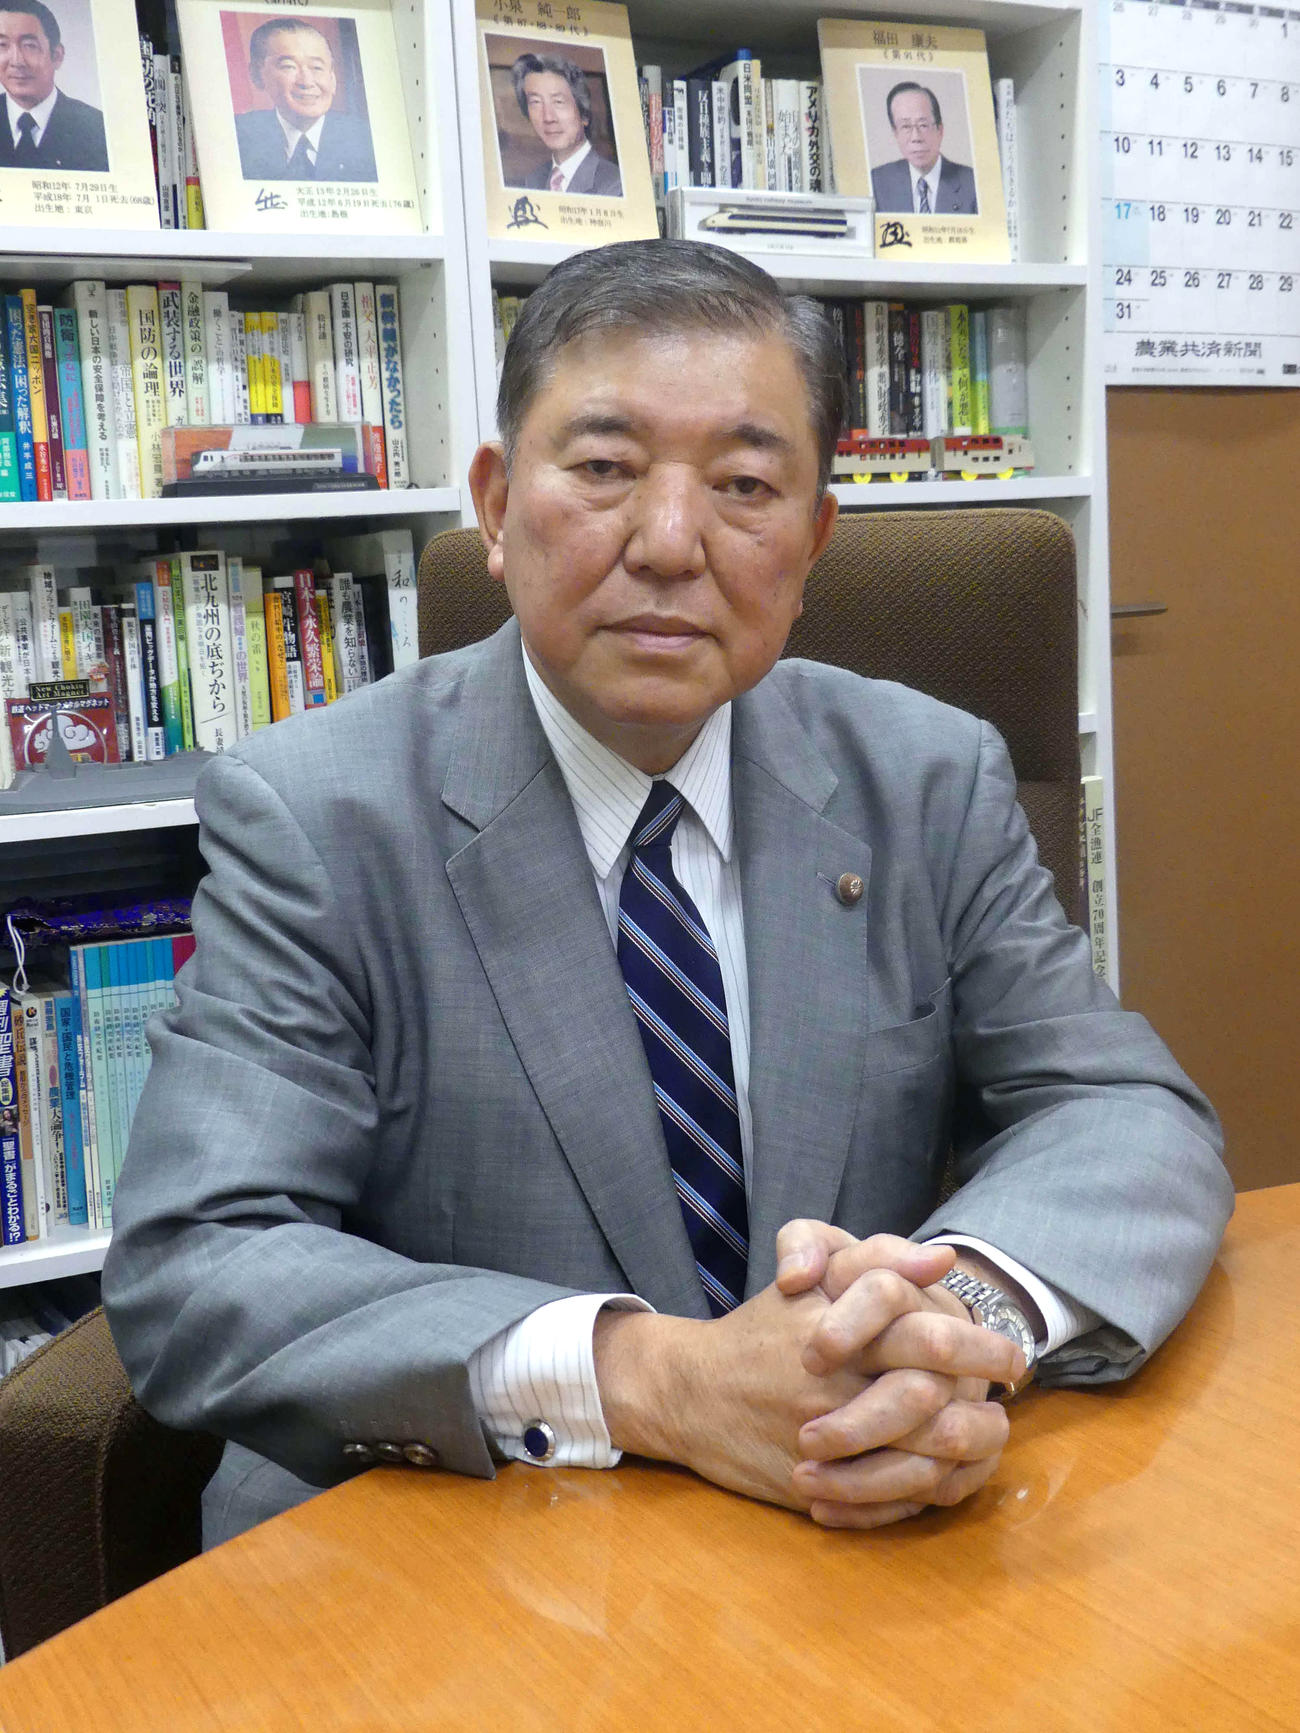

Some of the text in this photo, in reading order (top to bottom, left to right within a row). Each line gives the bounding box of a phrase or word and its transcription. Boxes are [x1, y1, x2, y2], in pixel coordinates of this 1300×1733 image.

[538, 2, 581, 20] 純一郎
[873, 30, 938, 49] 福田 康夫
[1281, 22, 1288, 38] 1
[1115, 69, 1290, 103] 3 4 5 6 7 8
[1114, 136, 1293, 166] 10 11 12 13 14 15
[1115, 203, 1293, 230] 17 18 19 20 21 22
[1115, 268, 1293, 292] 24 25 26 27 28 29
[1116, 302, 1132, 319] 31
[139, 309, 160, 397] 国防の論理
[163, 291, 185, 398] 武装する世界
[1134, 340, 1263, 359] 農業共済新聞
[9, 308, 32, 435] 困った憲法・困った解釈
[88, 309, 109, 441] 新しい日本の安全保障を考える
[379, 293, 403, 431] 新幹線がなかったら
[201, 573, 227, 714] 北九州の底ぢから
[339, 578, 359, 677] 誰も農業を知らない
[36, 685, 51, 693] New
[54, 689, 84, 698] Magnet
[1087, 807, 1103, 865] JF全漁連
[60, 1007, 76, 1101] 国家・国民と危機管理
